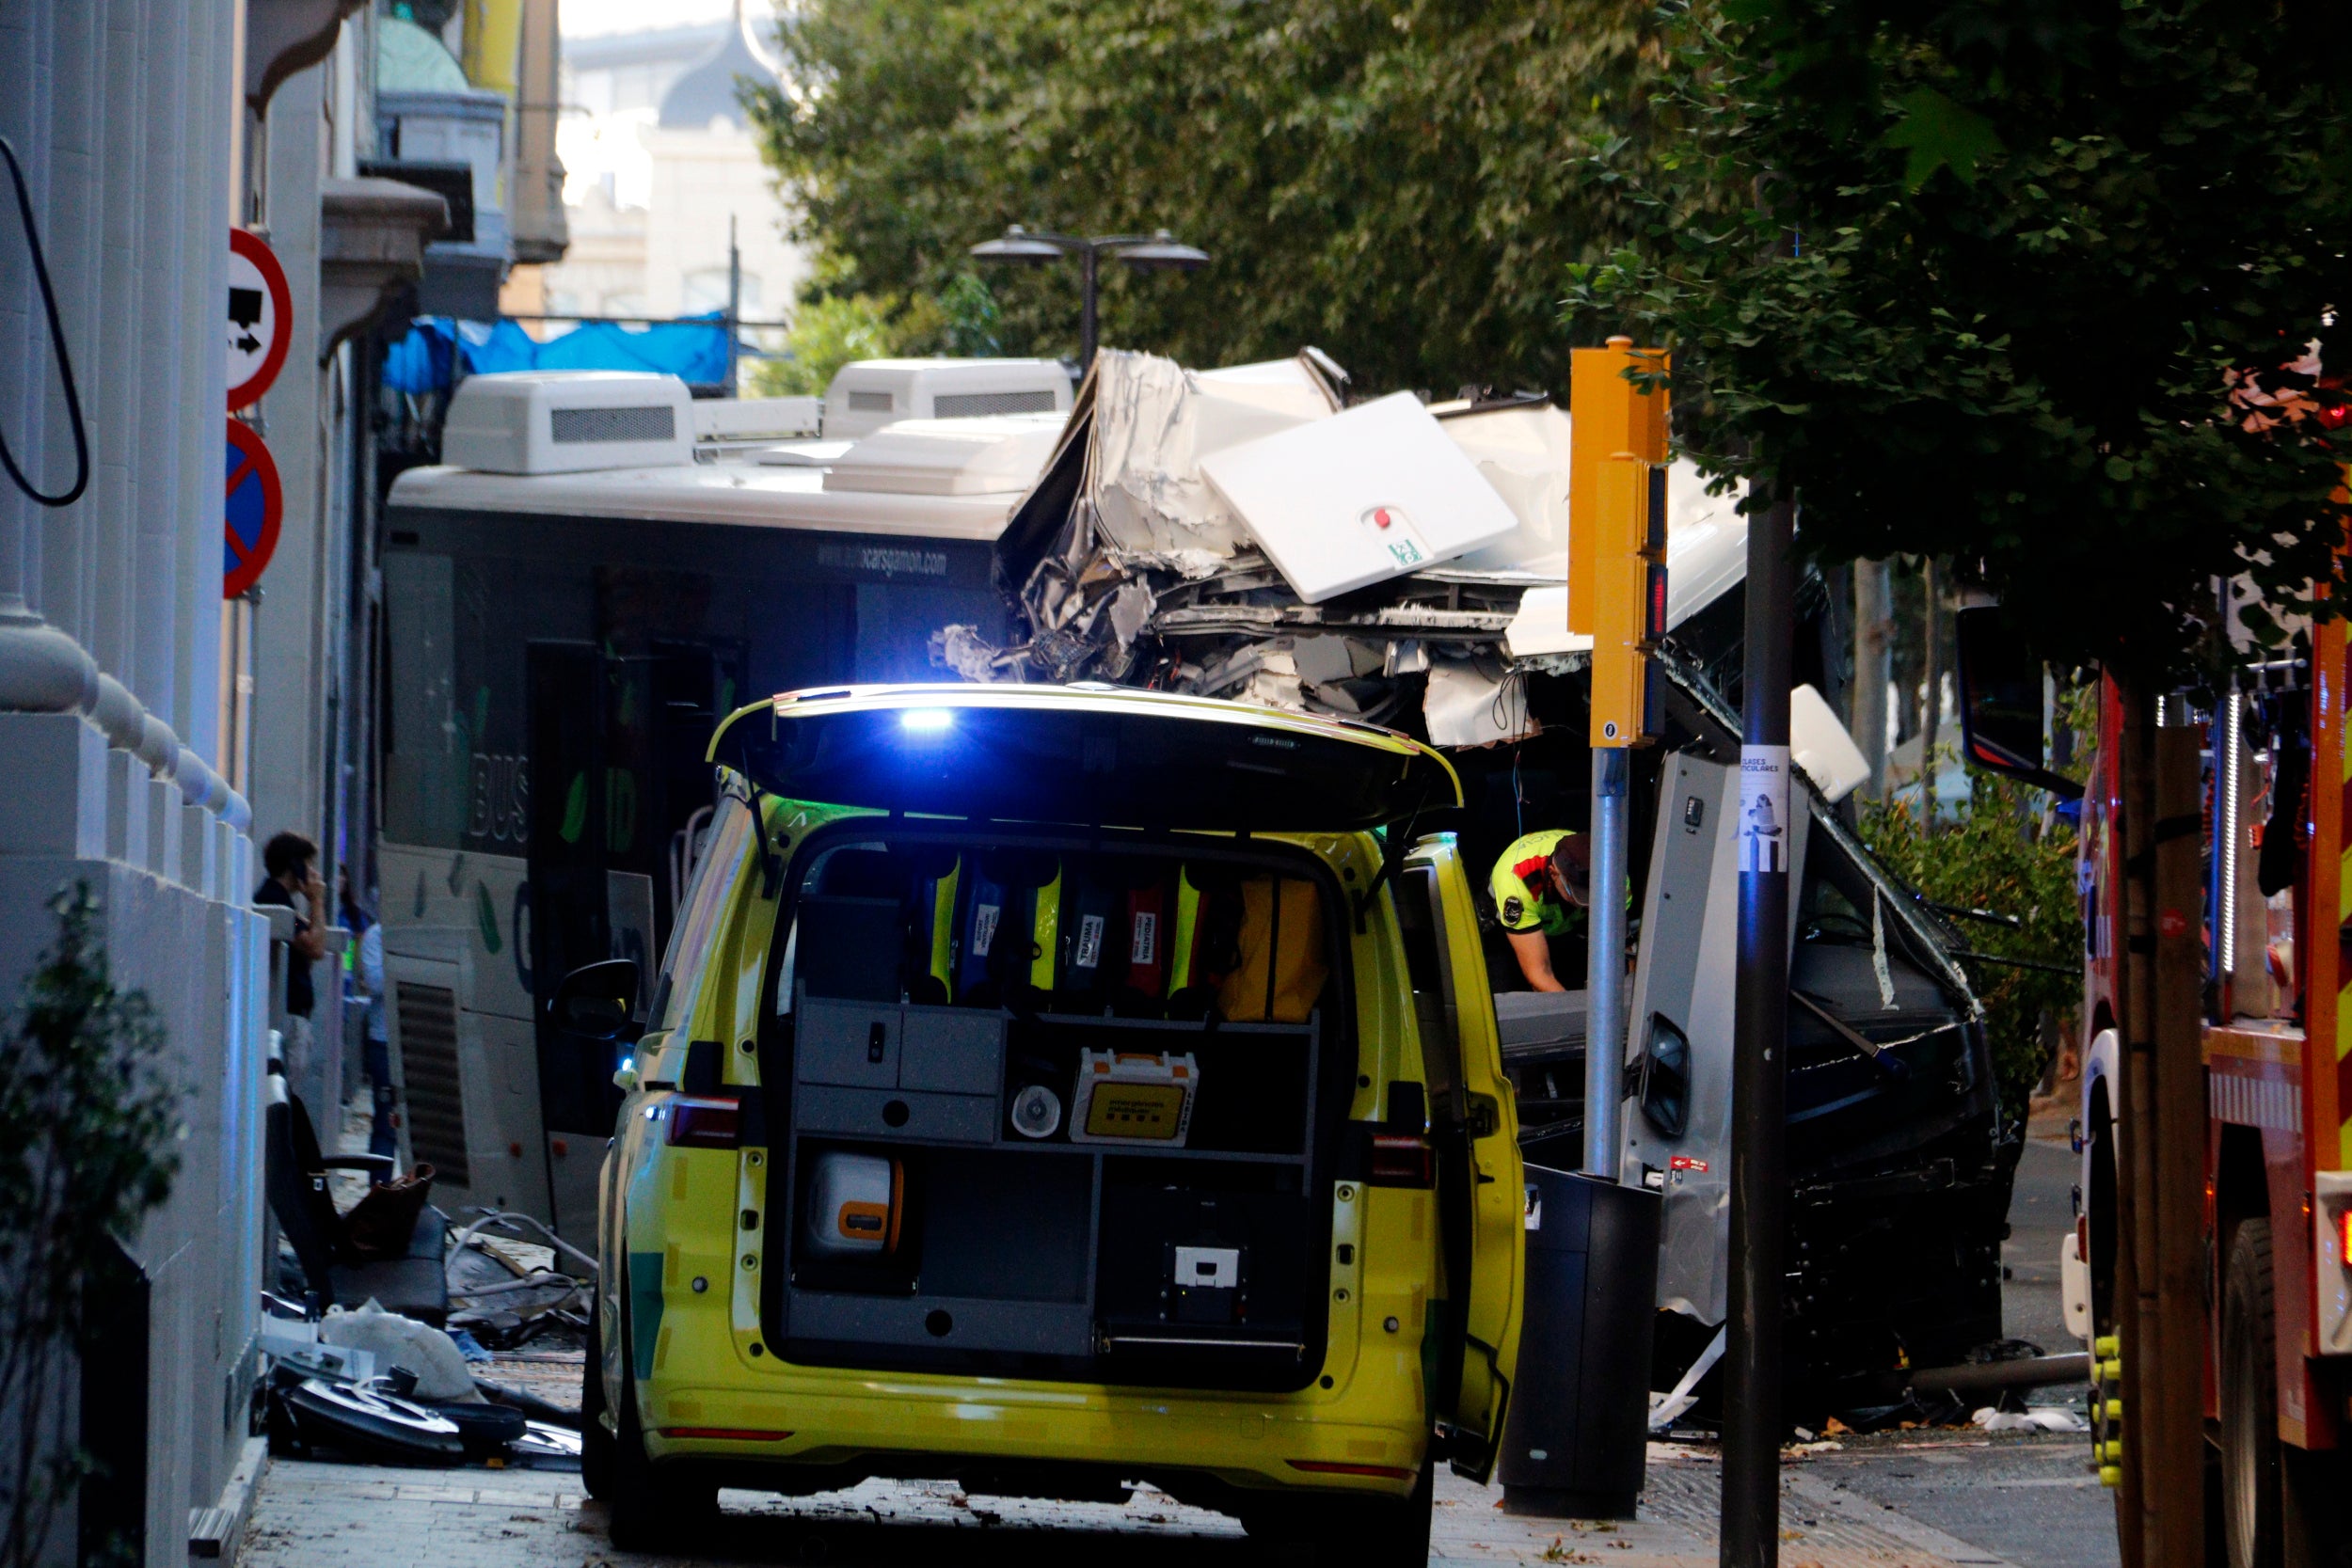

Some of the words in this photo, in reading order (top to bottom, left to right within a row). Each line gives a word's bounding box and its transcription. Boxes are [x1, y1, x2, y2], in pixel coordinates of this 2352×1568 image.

[469, 752, 529, 843] BUS
[1080, 922, 1092, 959] TRAUMA
[1142, 917, 1152, 959] PEDIATRIA
